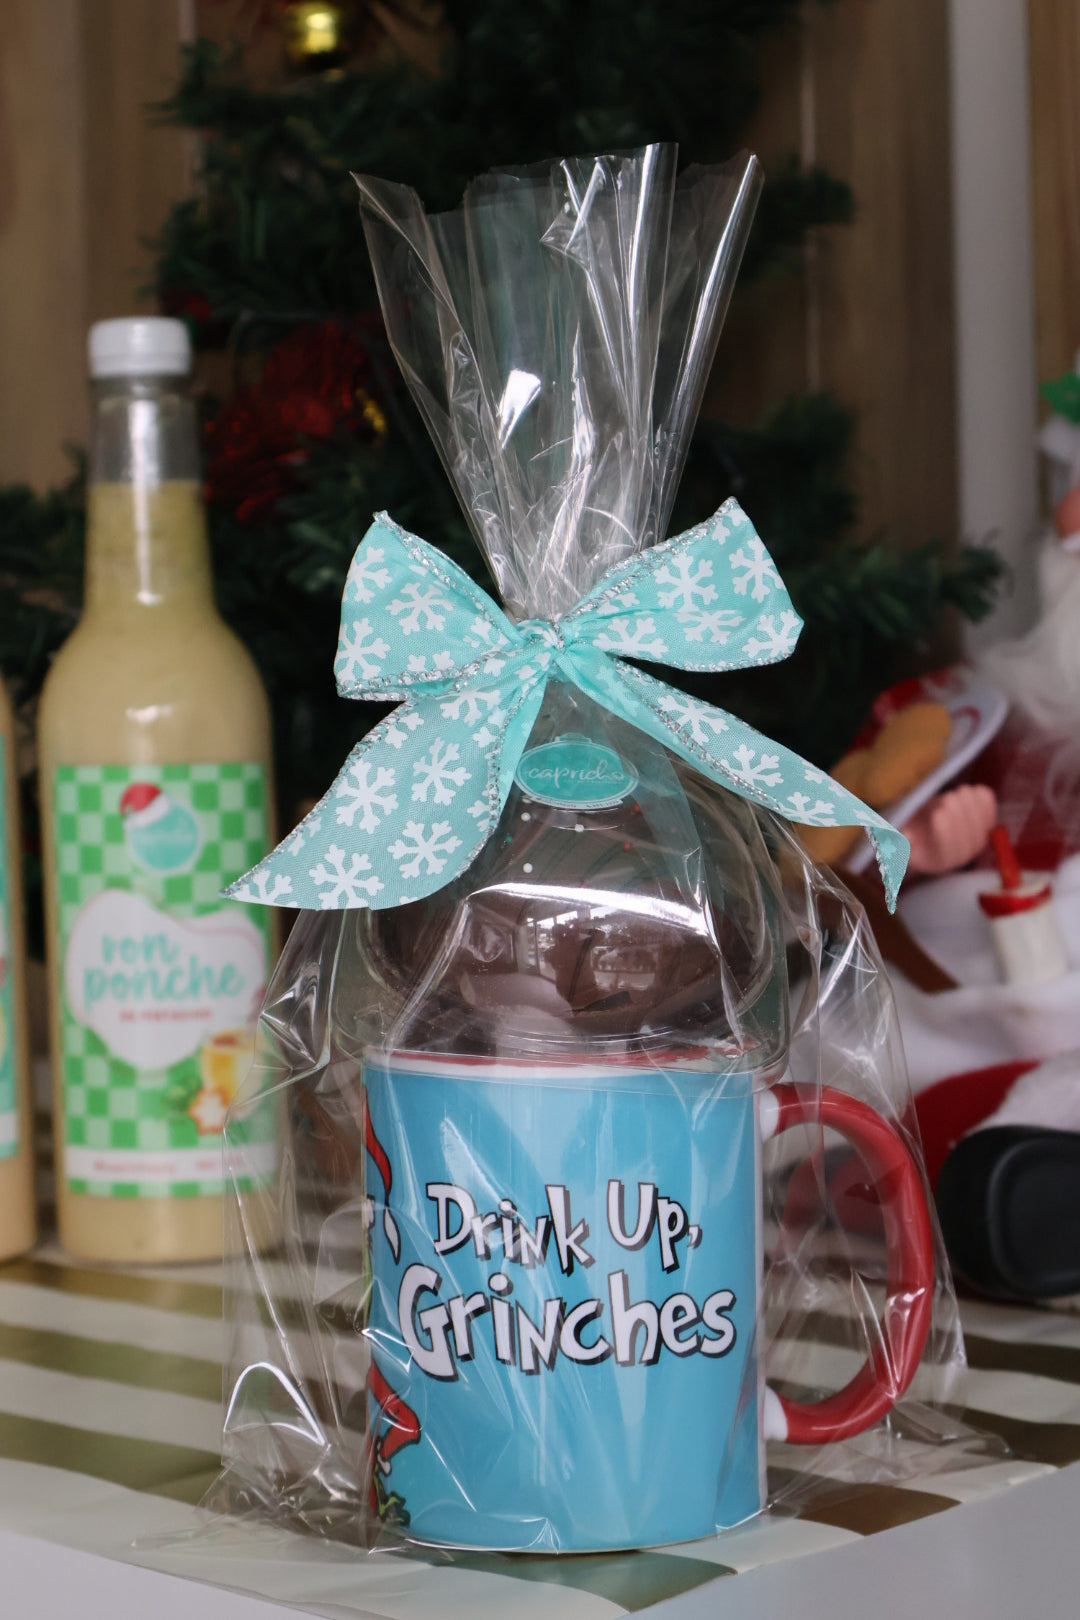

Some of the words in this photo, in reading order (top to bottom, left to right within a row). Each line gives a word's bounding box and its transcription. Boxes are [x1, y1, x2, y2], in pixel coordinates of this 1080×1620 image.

[528, 759, 626, 789] capricho
[84, 954, 246, 1013] ponche
[605, 1179, 703, 1273] Up,
